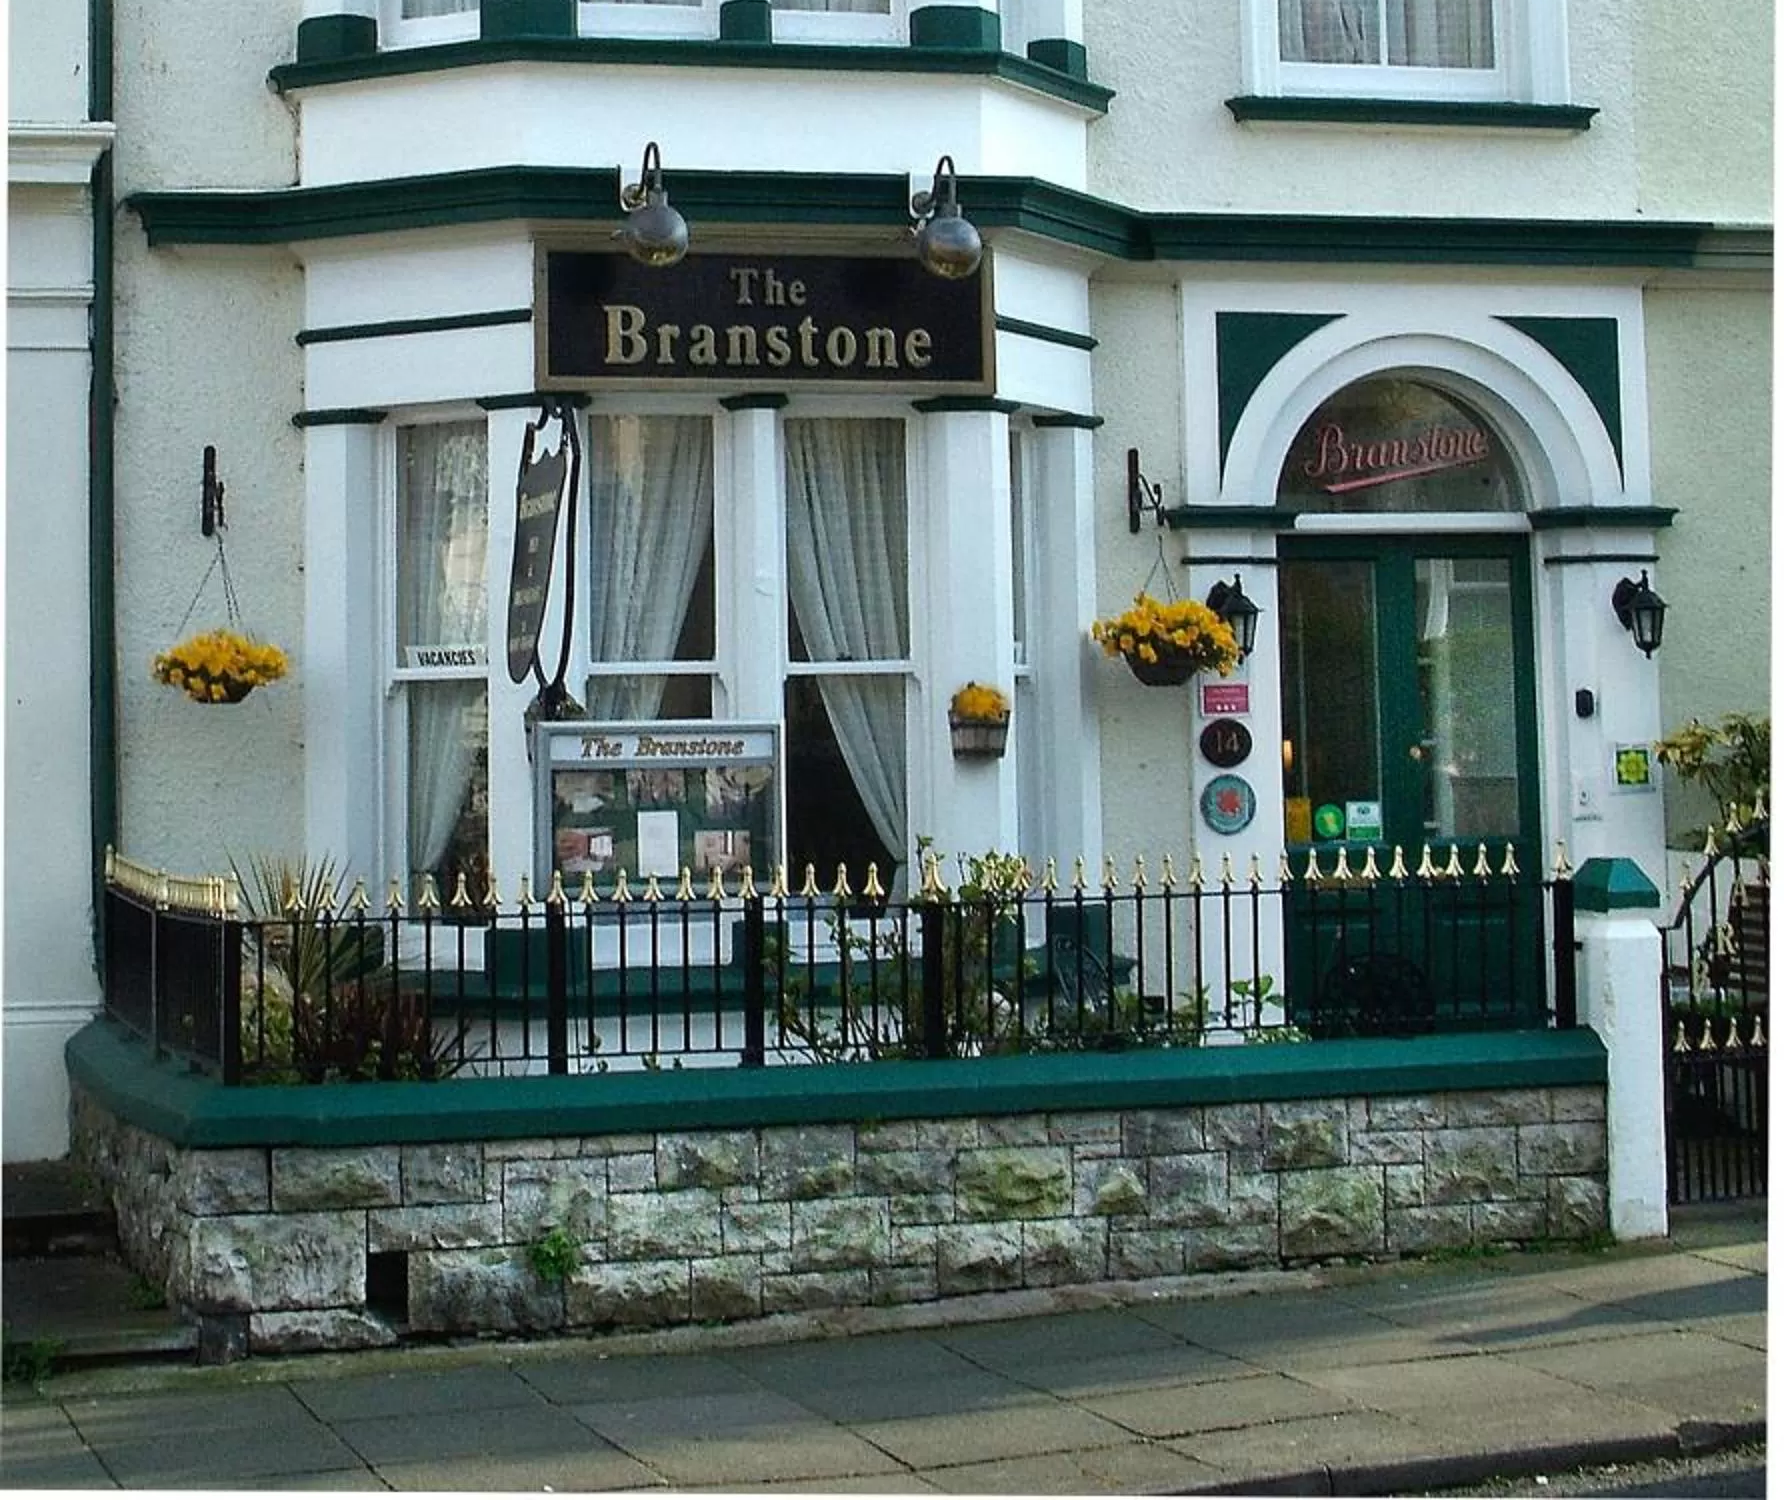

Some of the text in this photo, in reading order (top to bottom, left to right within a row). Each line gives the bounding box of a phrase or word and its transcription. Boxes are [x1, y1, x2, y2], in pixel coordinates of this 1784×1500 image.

[731, 267, 806, 304] The
[603, 305, 932, 368] Branstone
[1305, 424, 1486, 476] Branstone
[417, 649, 476, 666] VACANCIES
[580, 733, 745, 758] The Branstone
[1216, 731, 1239, 753] 14
